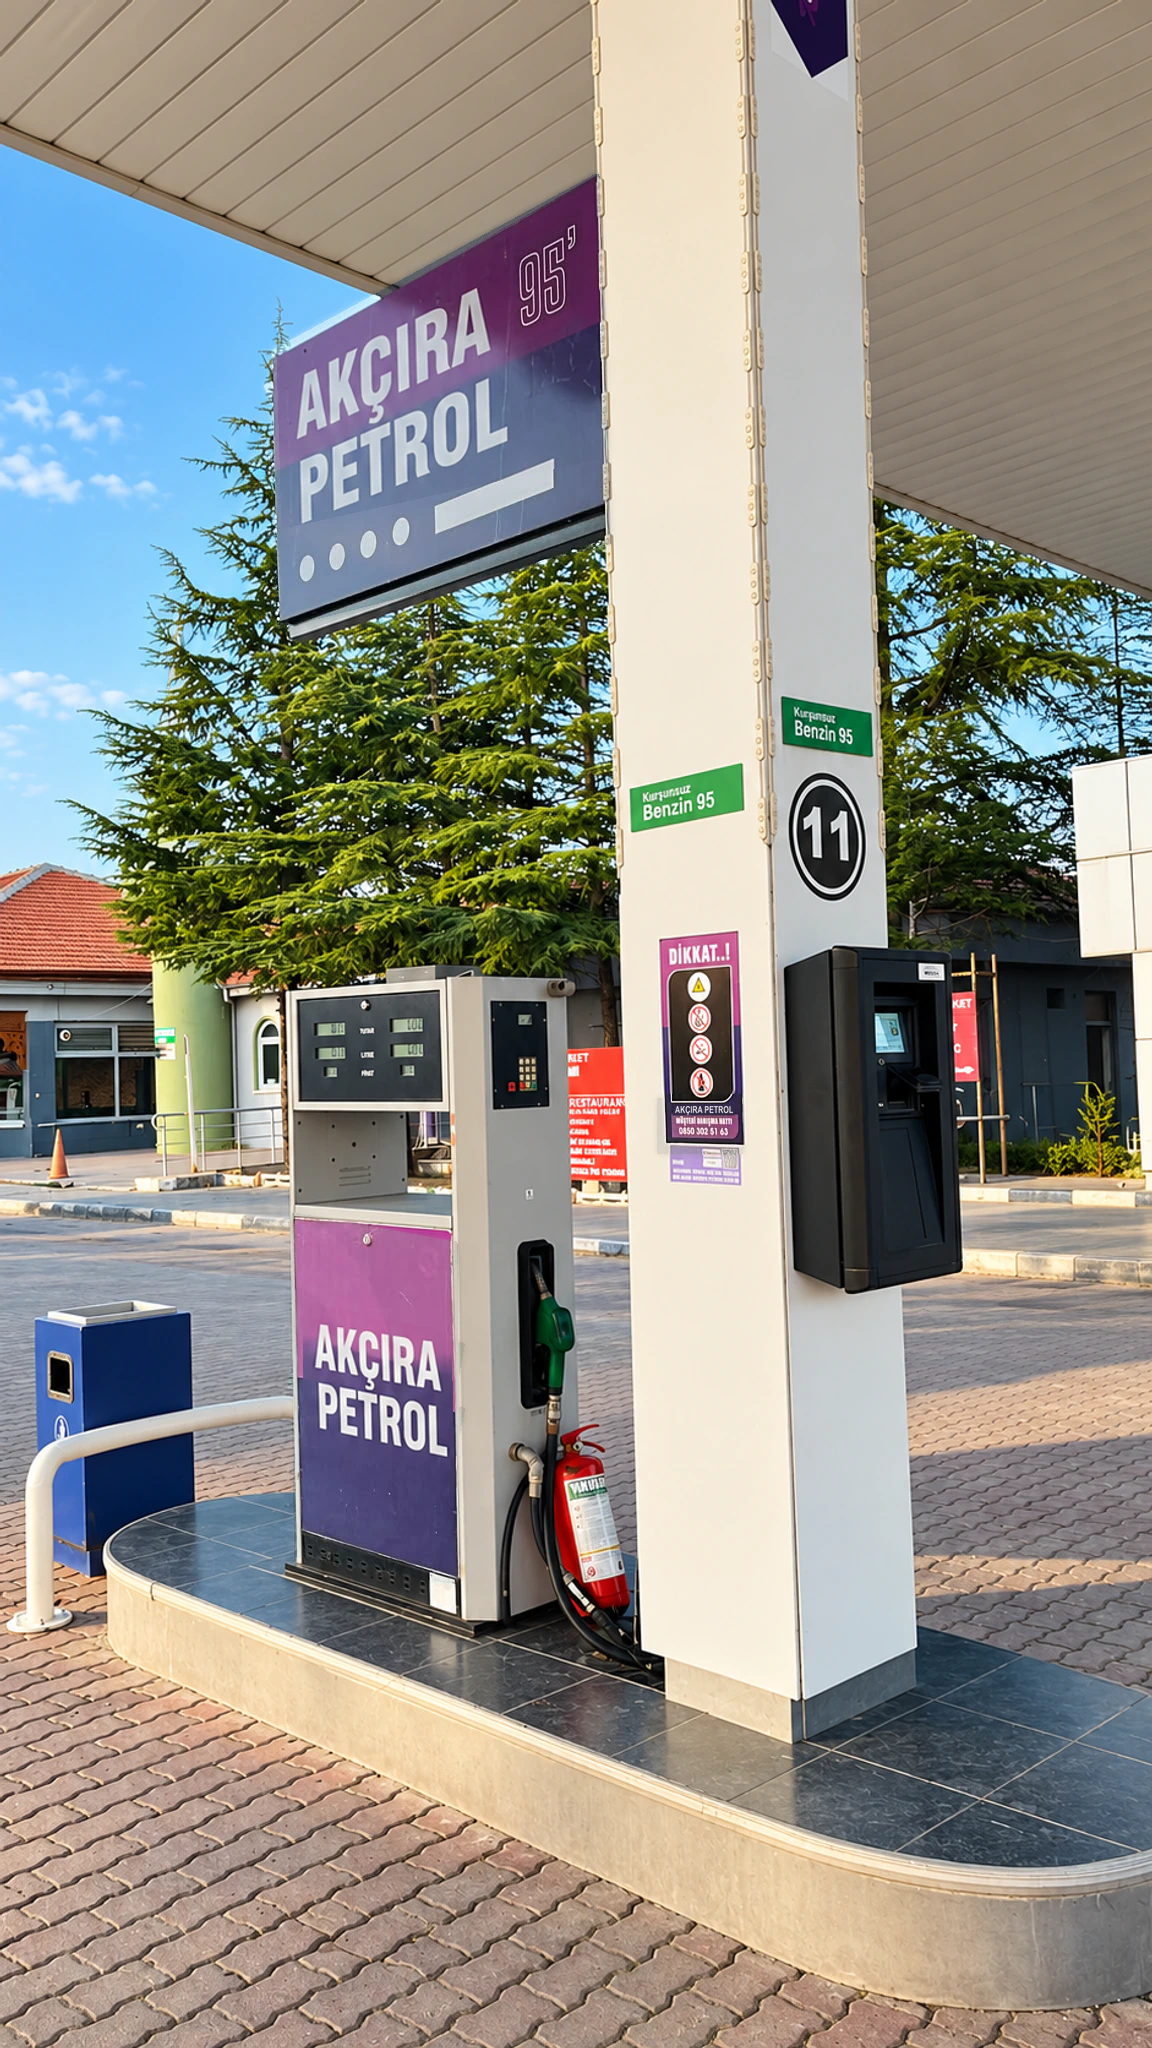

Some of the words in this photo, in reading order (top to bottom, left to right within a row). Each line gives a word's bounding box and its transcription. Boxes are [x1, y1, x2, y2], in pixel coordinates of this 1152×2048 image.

[296, 288, 491, 439] AKÇIRA
[299, 378, 509, 524] PETROL
[794, 720, 836, 743] Benzin
[838, 727, 854, 745] 95
[642, 785, 692, 803] Kurşunsuz
[643, 797, 693, 822] Benzin
[696, 791, 715, 811] 95
[802, 805, 850, 862] 11
[675, 1105, 703, 1115] AKÇIRA
[704, 1105, 734, 1114] PETROL
[678, 1127, 695, 1135] 0850
[696, 1127, 709, 1136] 302
[719, 1128, 729, 1136] 63
[314, 1323, 442, 1392] AKÇIRA
[318, 1382, 448, 1458] PETROL
